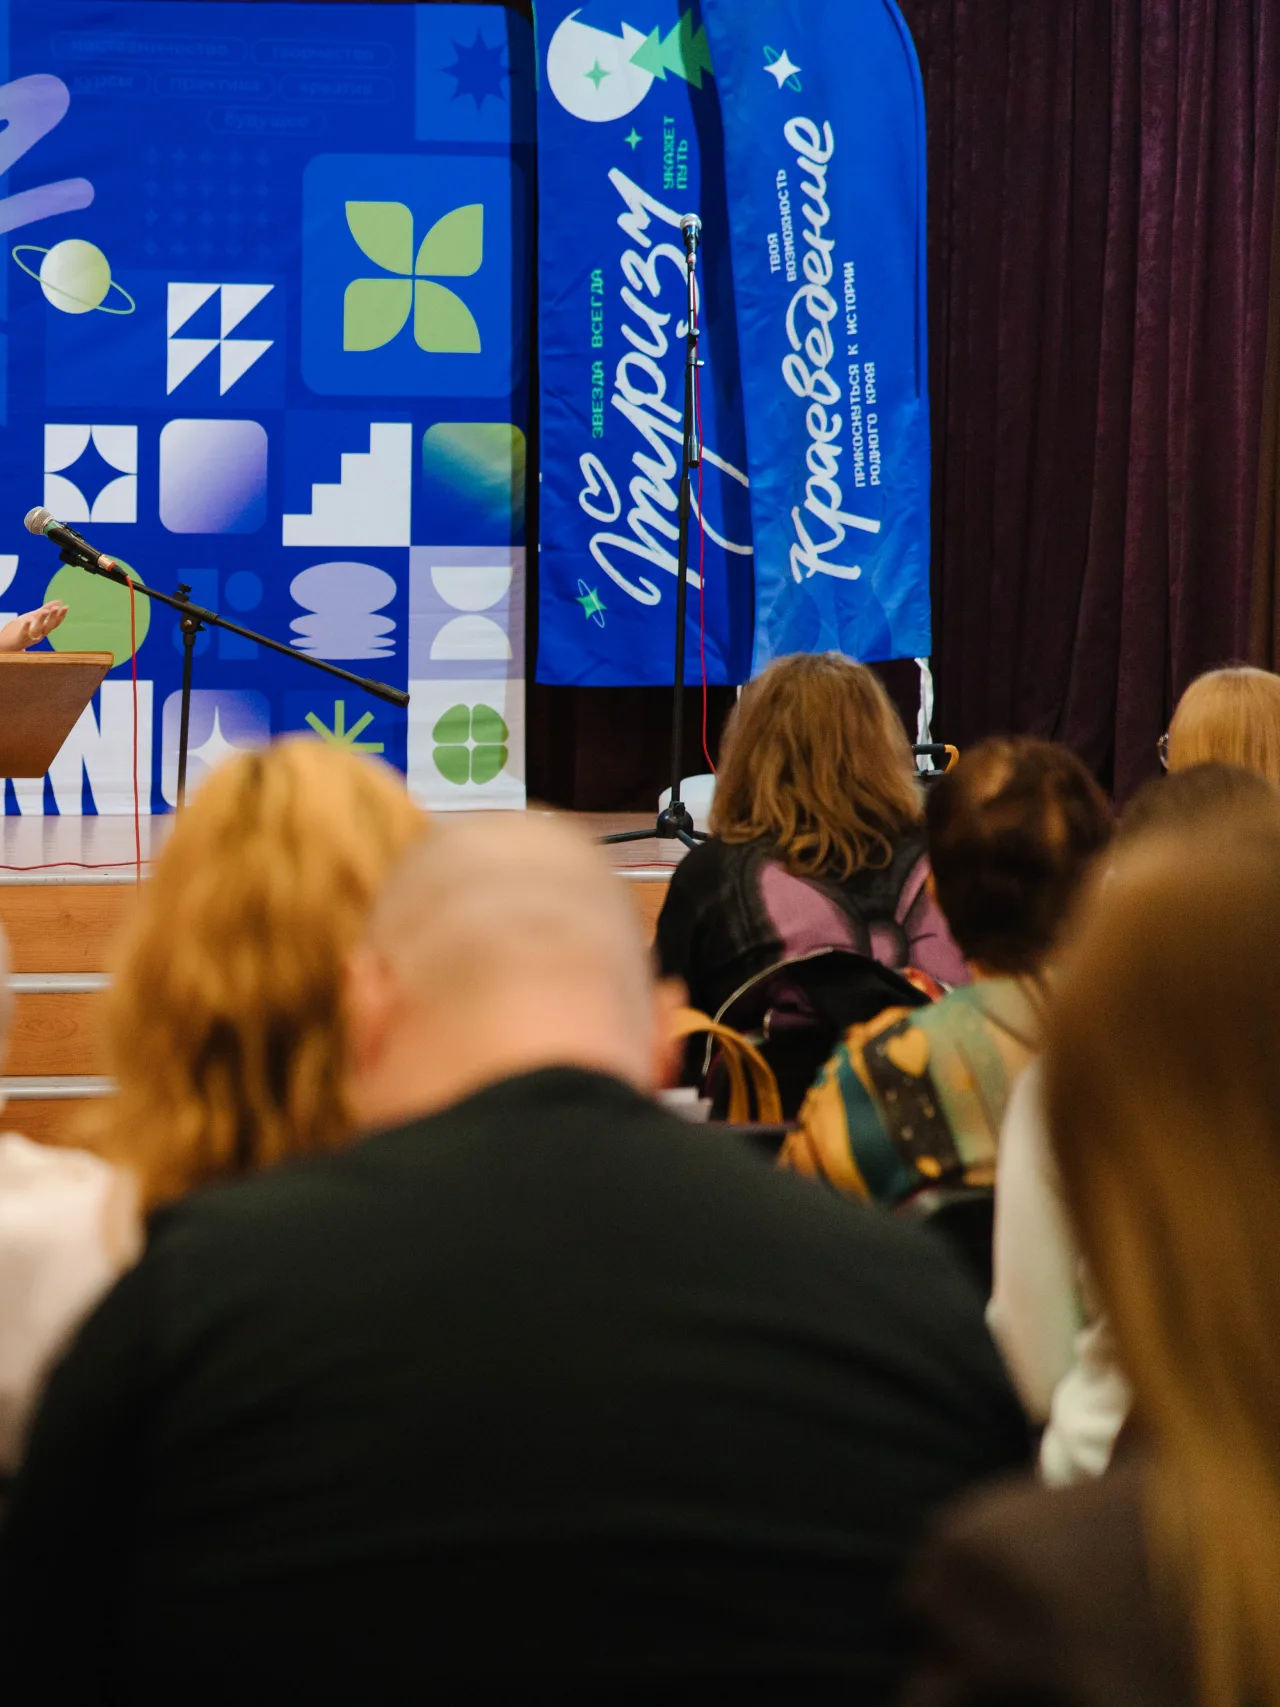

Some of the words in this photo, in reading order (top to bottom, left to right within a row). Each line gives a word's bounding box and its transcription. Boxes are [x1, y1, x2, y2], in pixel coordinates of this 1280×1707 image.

[663, 115, 675, 191] УКАЖЕТ
[675, 138, 688, 191] ПУТЬ
[767, 232, 781, 274] ТВОЯ
[775, 168, 797, 283] ВОЗМОЖНОСТЬ
[590, 268, 604, 349] ВСЕГДА
[842, 261, 858, 336] ИСТОРИИ
[784, 116, 880, 583] Краеведение
[847, 343, 859, 356] К
[863, 361, 877, 405] КРАЯ
[591, 360, 605, 439] ЗВЕЗДА
[848, 363, 867, 488] ПРИКОСНУТЬСЯ
[865, 412, 881, 487] РОДНОГО
